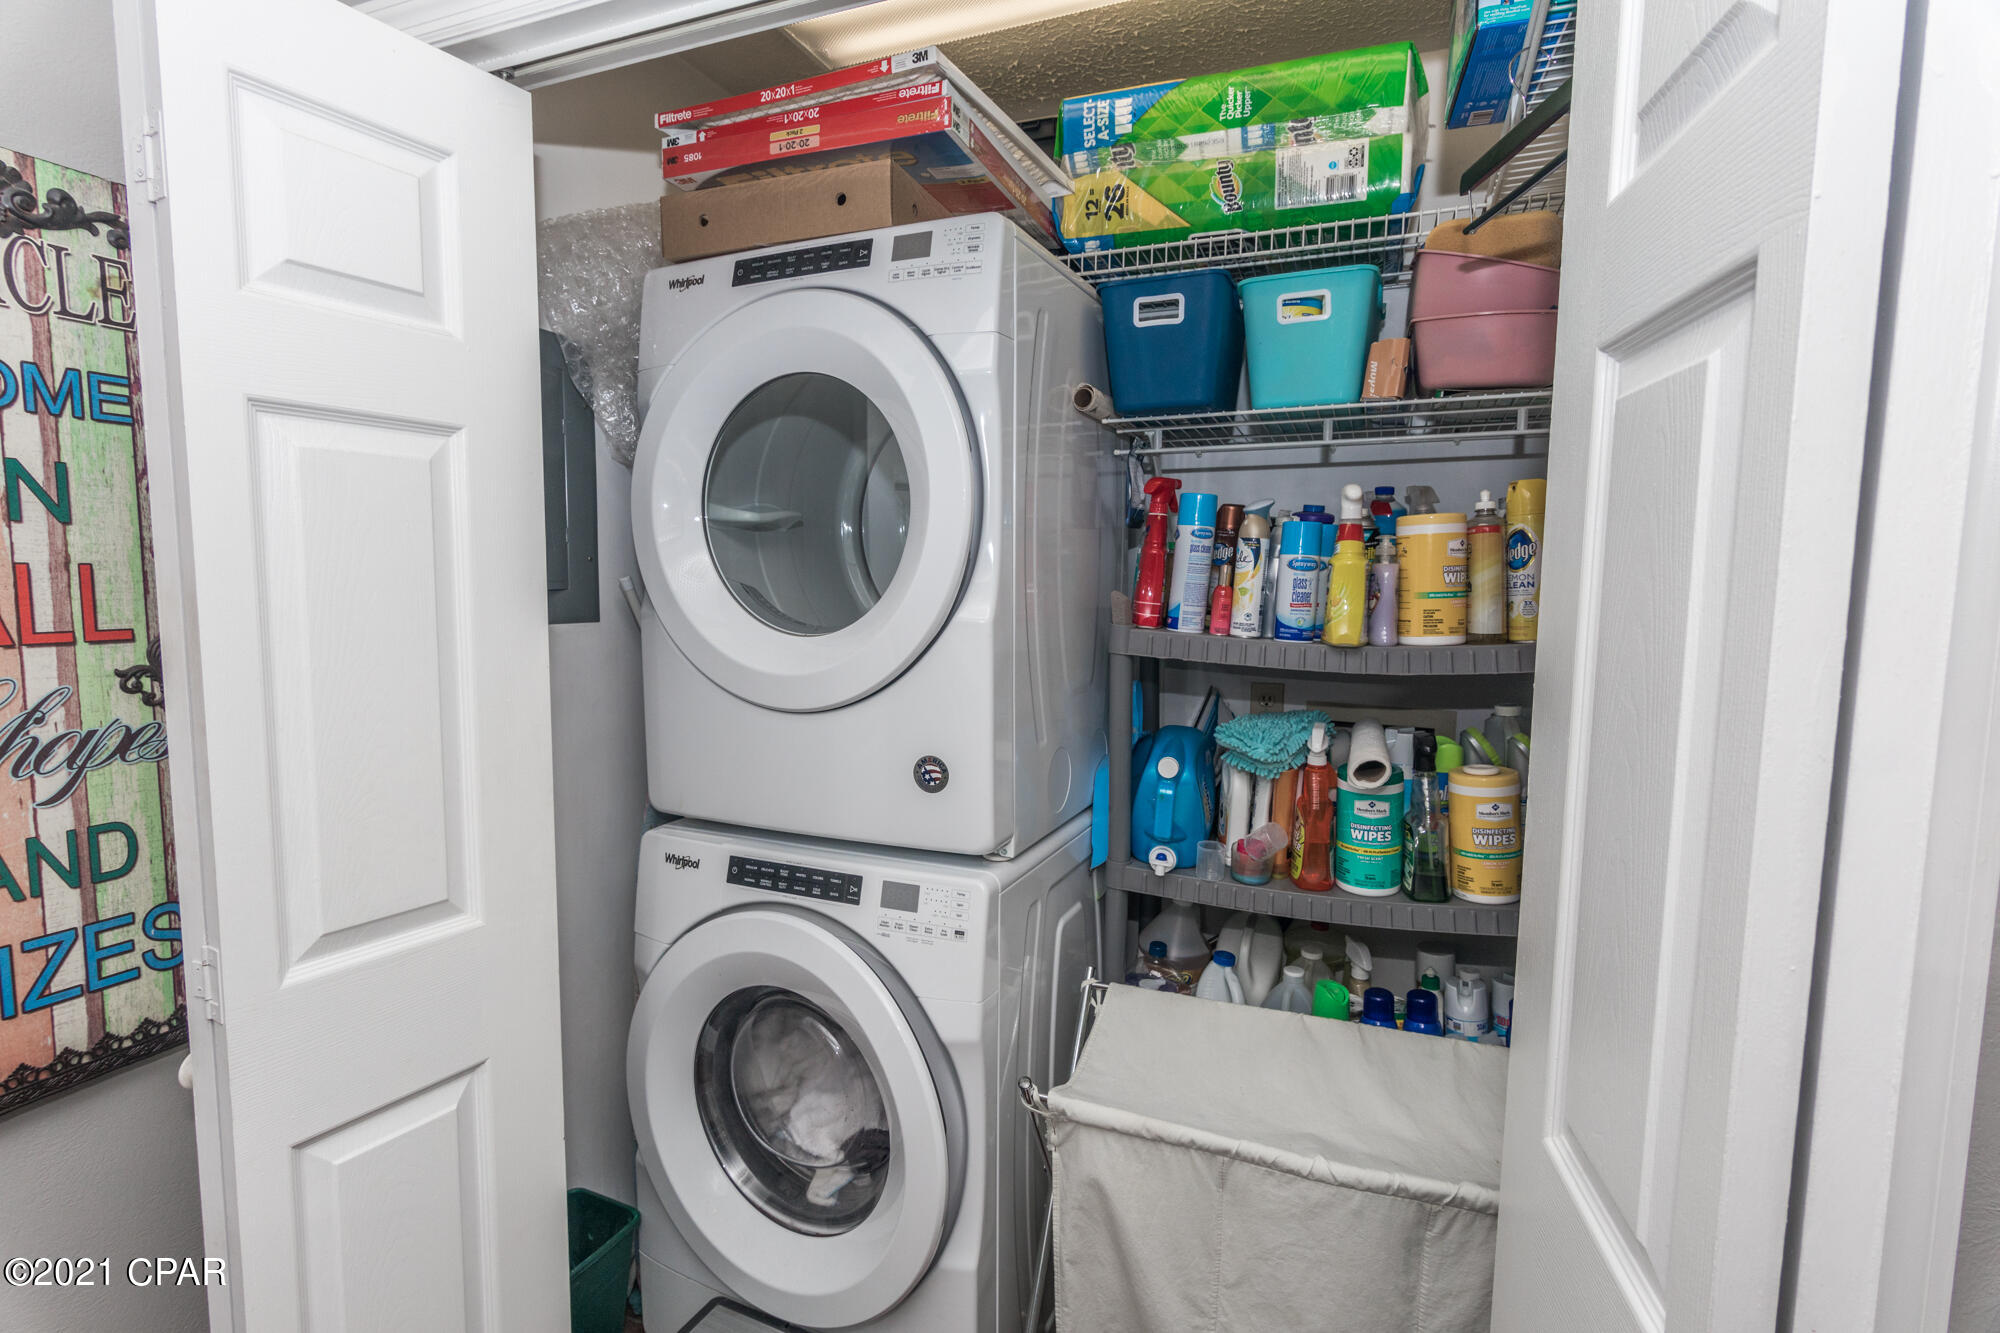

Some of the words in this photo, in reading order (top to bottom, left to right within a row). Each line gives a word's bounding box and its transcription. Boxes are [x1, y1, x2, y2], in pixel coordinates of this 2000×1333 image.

[912, 50, 928, 64] 3M
[760, 84, 795, 103] 20x20x1
[898, 83, 940, 98] Filtrete
[1226, 85, 1236, 121] Quicker
[1234, 90, 1243, 121] Picker
[1242, 89, 1252, 119] Upper
[659, 109, 692, 125] Filtrete
[784, 107, 820, 124] 20x20x1
[897, 108, 940, 123] Filtrete
[1097, 98, 1110, 141] A-SIZE
[1219, 103, 1227, 122] The
[1083, 97, 1097, 149] SELECT-
[666, 137, 680, 148] 3M
[666, 155, 679, 166] 3M
[683, 152, 702, 162] 1085
[1220, 156, 1237, 215] Bounty
[1085, 199, 1099, 221] 12
[1103, 183, 1126, 222] 26
[0, 234, 138, 334] CLE
[668, 273, 705, 293] Whirlpool
[1292, 576, 1308, 591] glass
[0, 562, 136, 649] LL
[1291, 590, 1312, 604] cleaner
[1350, 822, 1393, 831] DISINFECTING
[1350, 829, 1392, 842] WIPES
[1472, 827, 1517, 835] DISINFECTING
[1473, 833, 1517, 846] WIPES
[664, 852, 701, 870] Whirlpool
